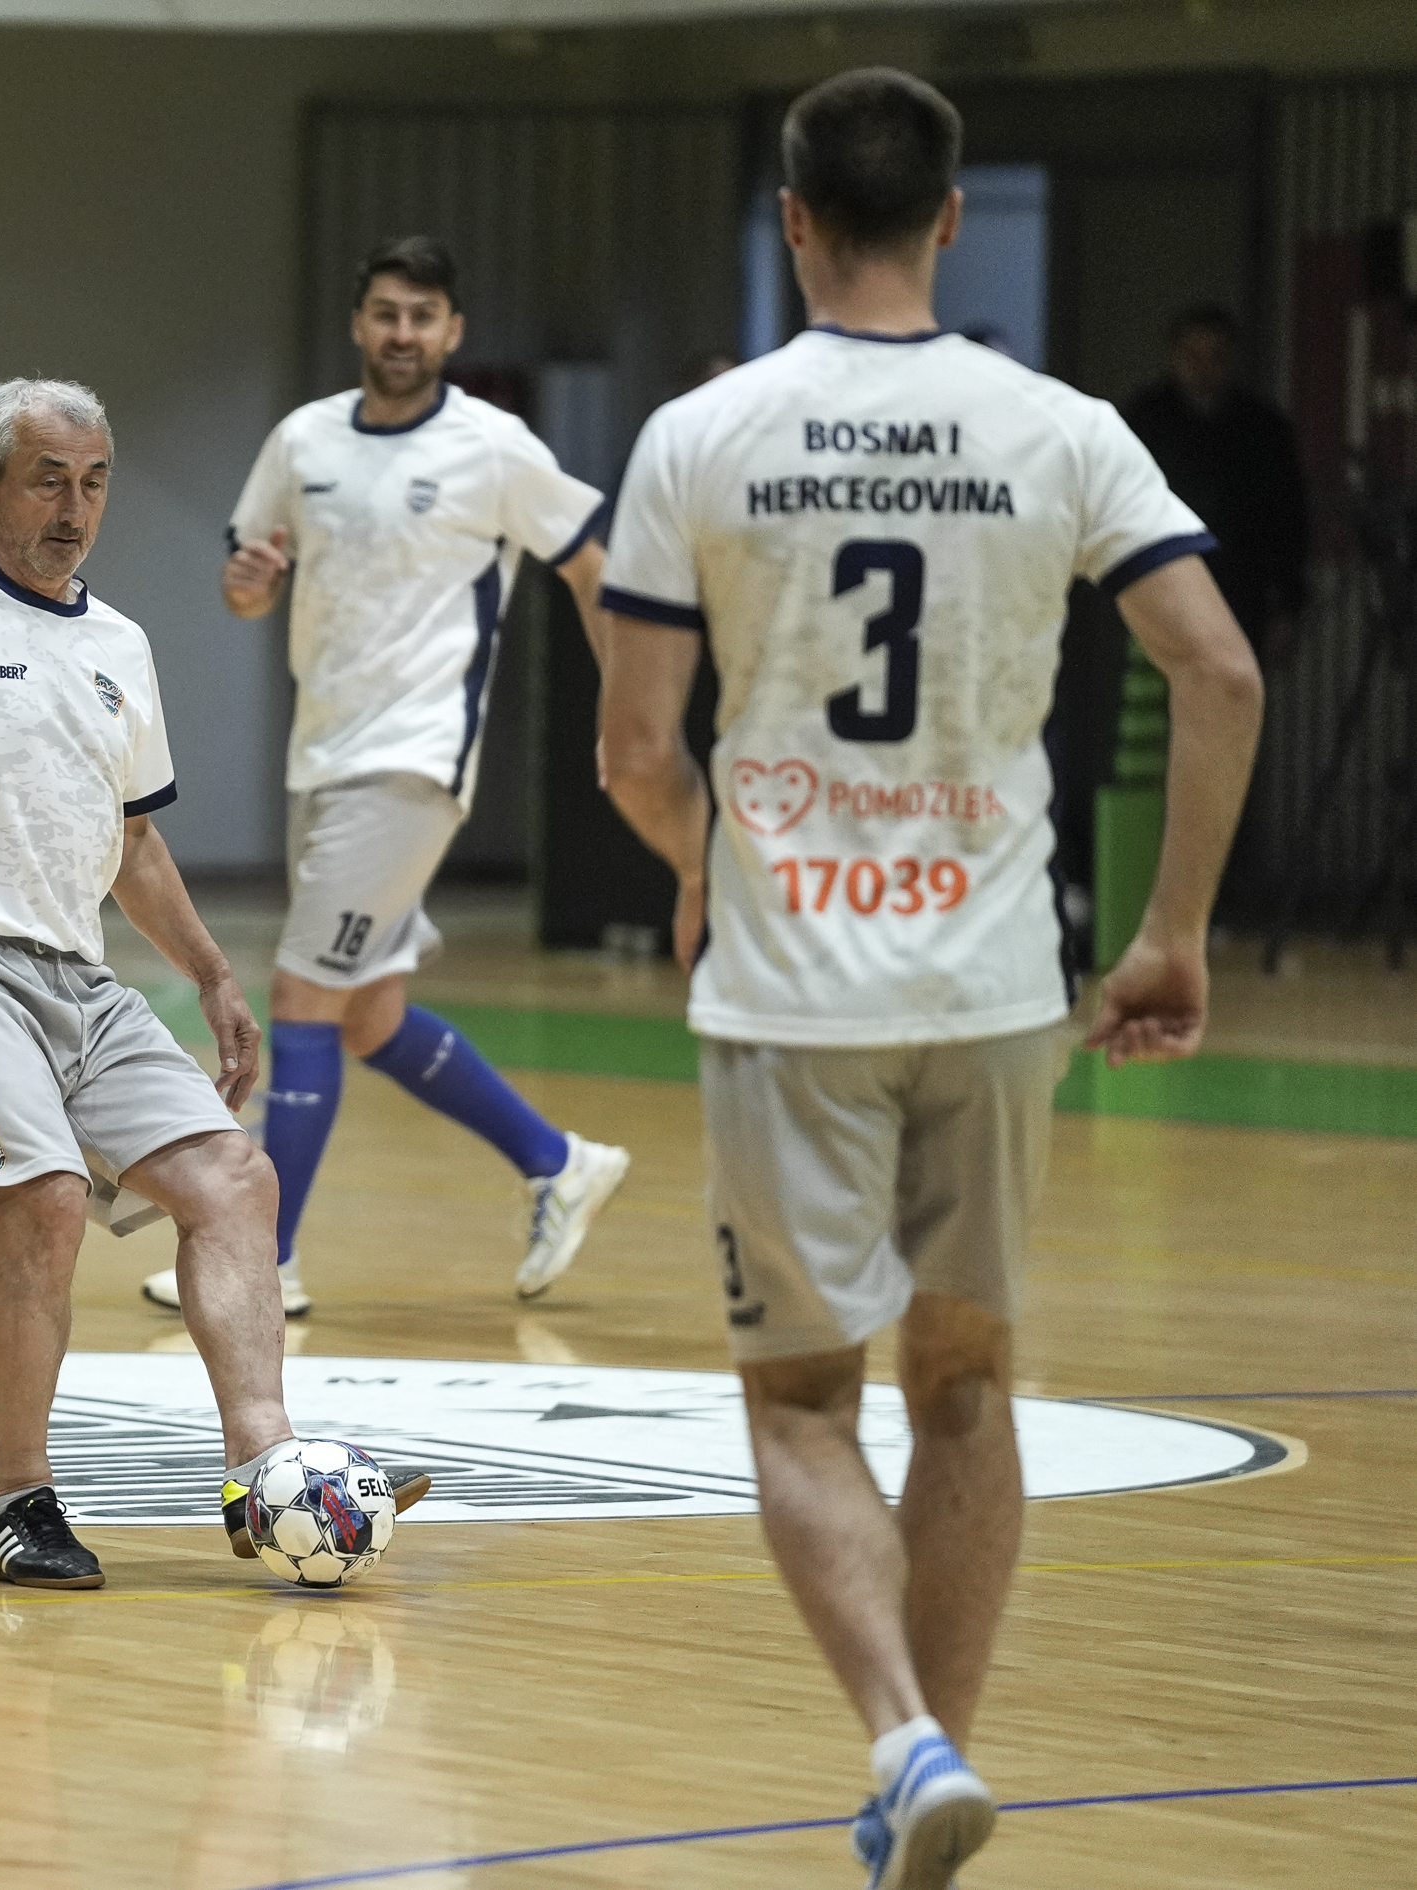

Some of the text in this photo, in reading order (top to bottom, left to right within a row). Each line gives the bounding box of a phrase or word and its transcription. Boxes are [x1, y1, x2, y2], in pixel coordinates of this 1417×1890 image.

[804, 419, 959, 454] BOSNA I
[746, 473, 1015, 517] HERCEGOVINA
[825, 537, 926, 743] 3
[773, 857, 969, 915] 17039
[331, 910, 373, 957] 18
